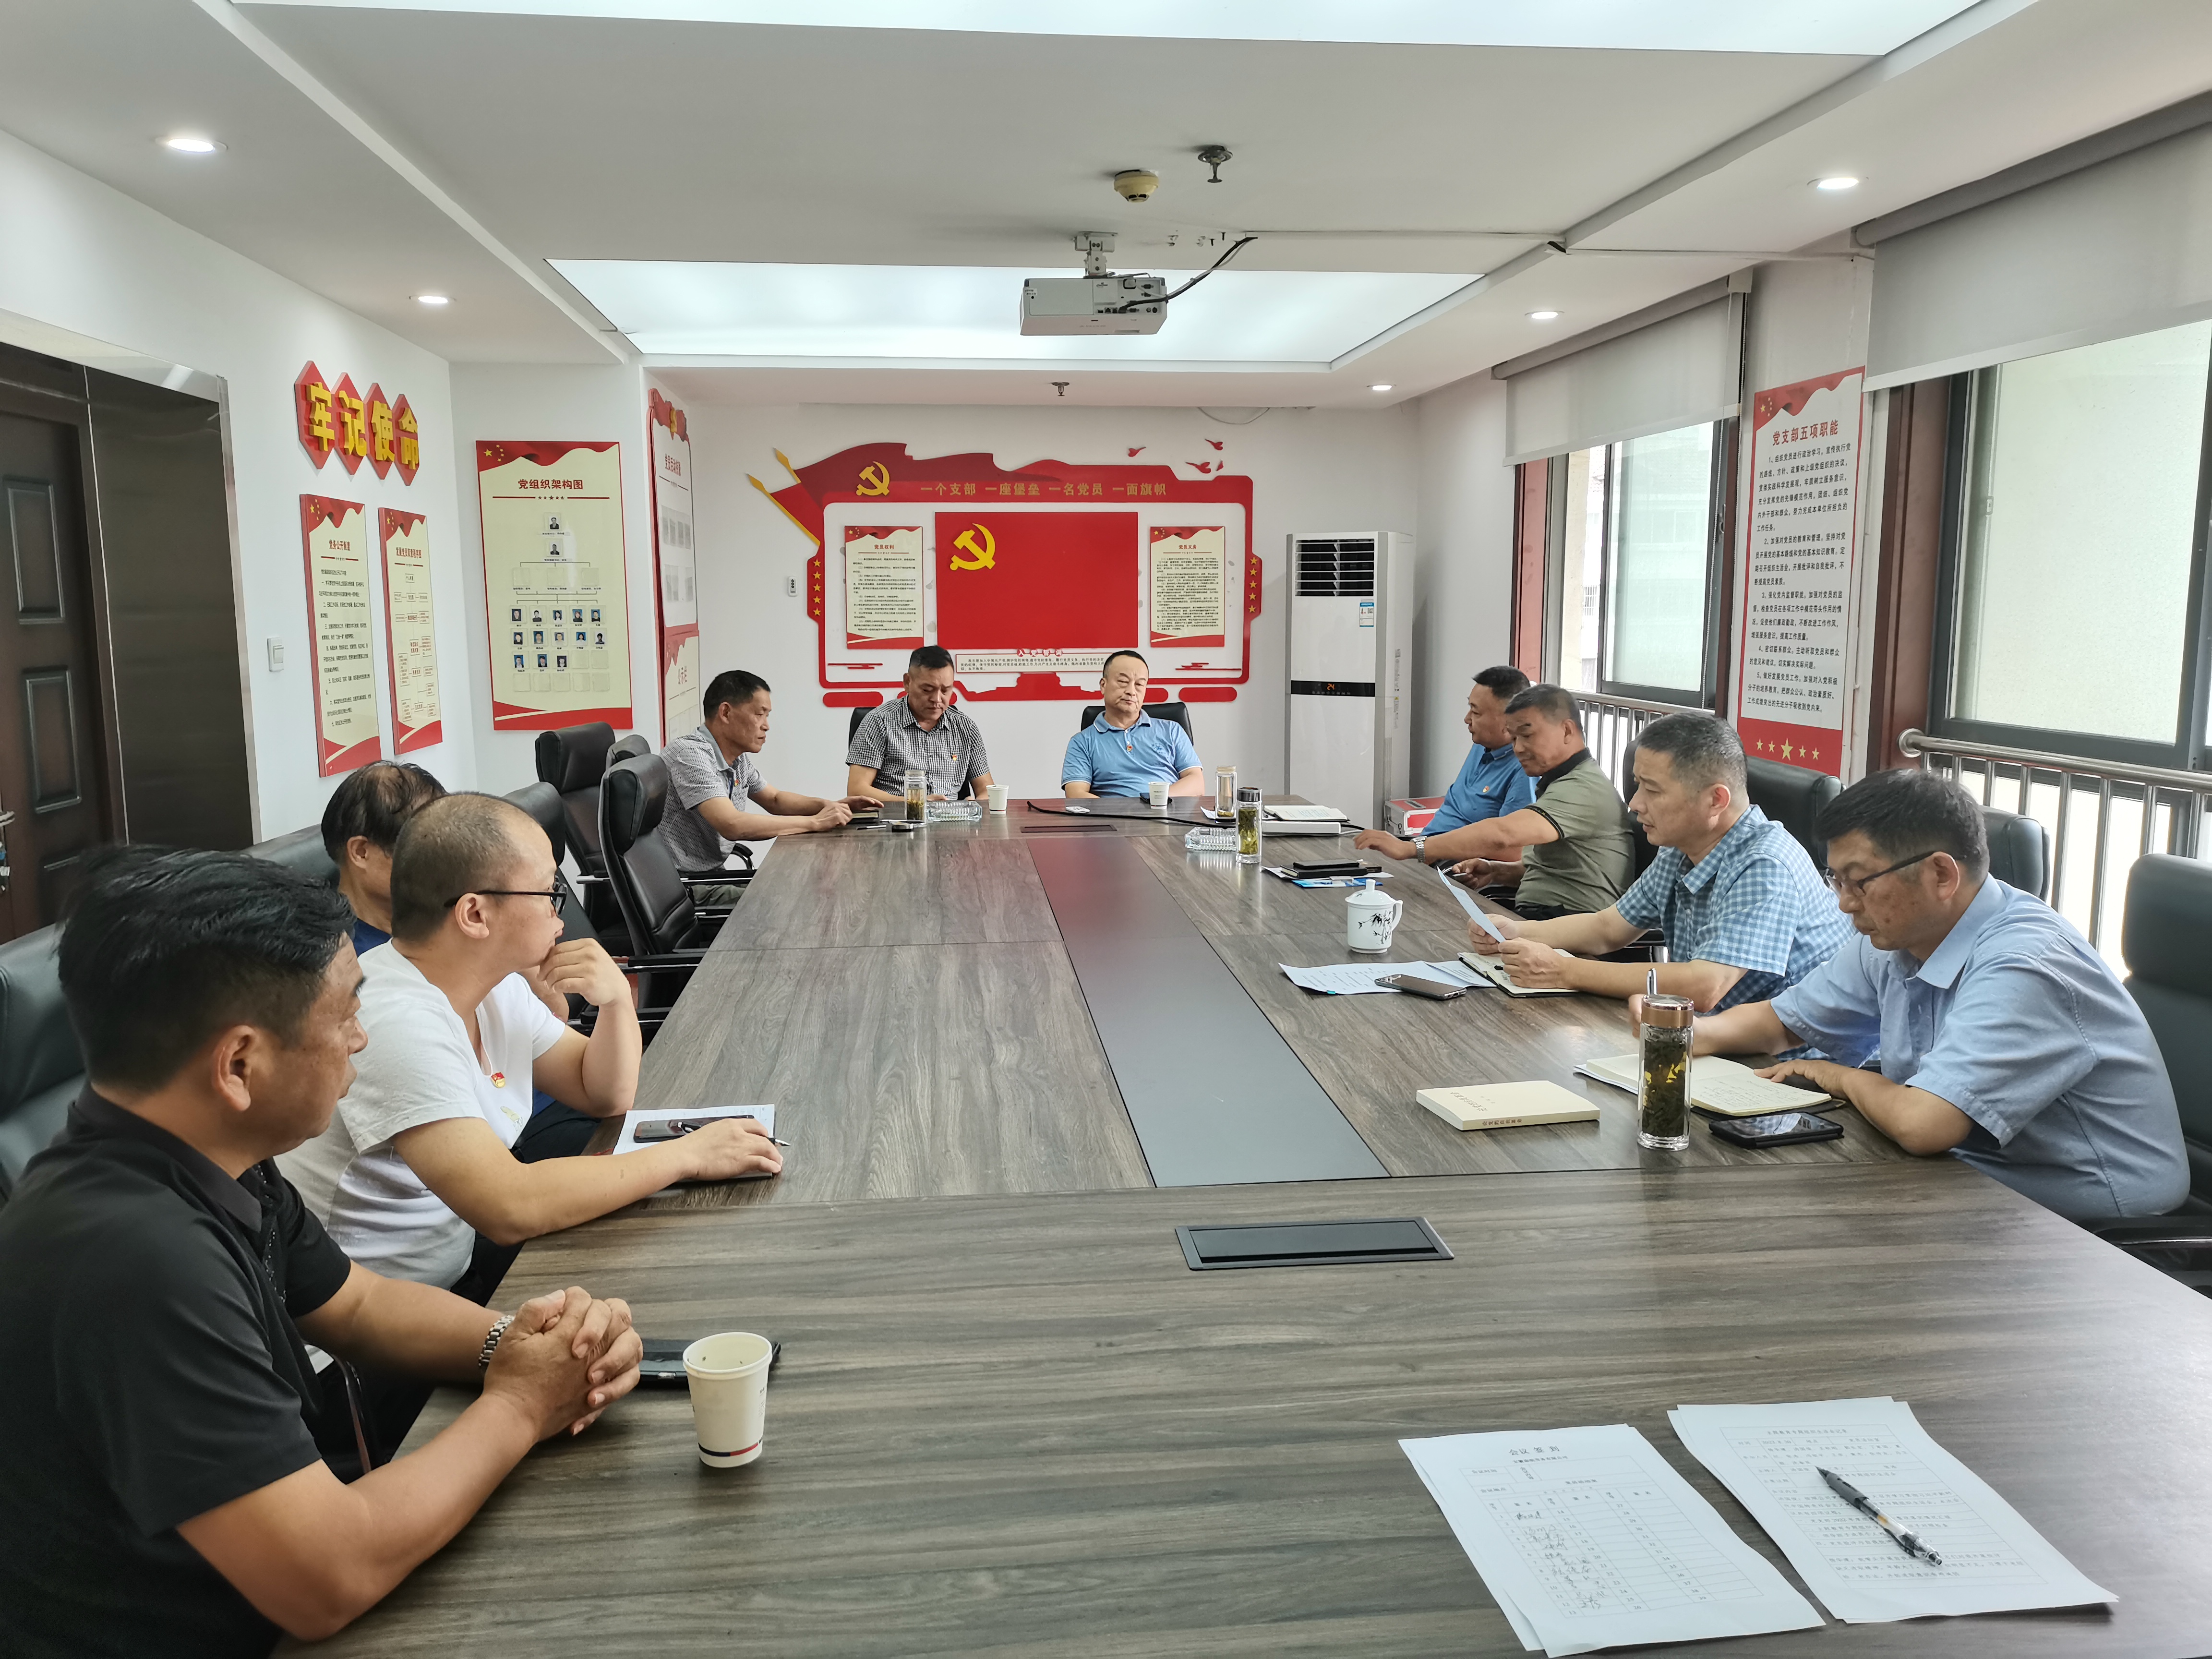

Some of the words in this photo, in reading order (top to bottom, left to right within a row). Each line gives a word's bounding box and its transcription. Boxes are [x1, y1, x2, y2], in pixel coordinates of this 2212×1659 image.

[306, 382, 419, 469] 牢记使命
[1773, 420, 1838, 446] 党支部五项职能
[518, 479, 583, 489] 党组织架构图
[921, 483, 976, 495] 一个支部
[985, 483, 1040, 495] 一座堡垒
[1049, 483, 1103, 495] 一名党员
[1112, 483, 1166, 495] 一面旗帜
